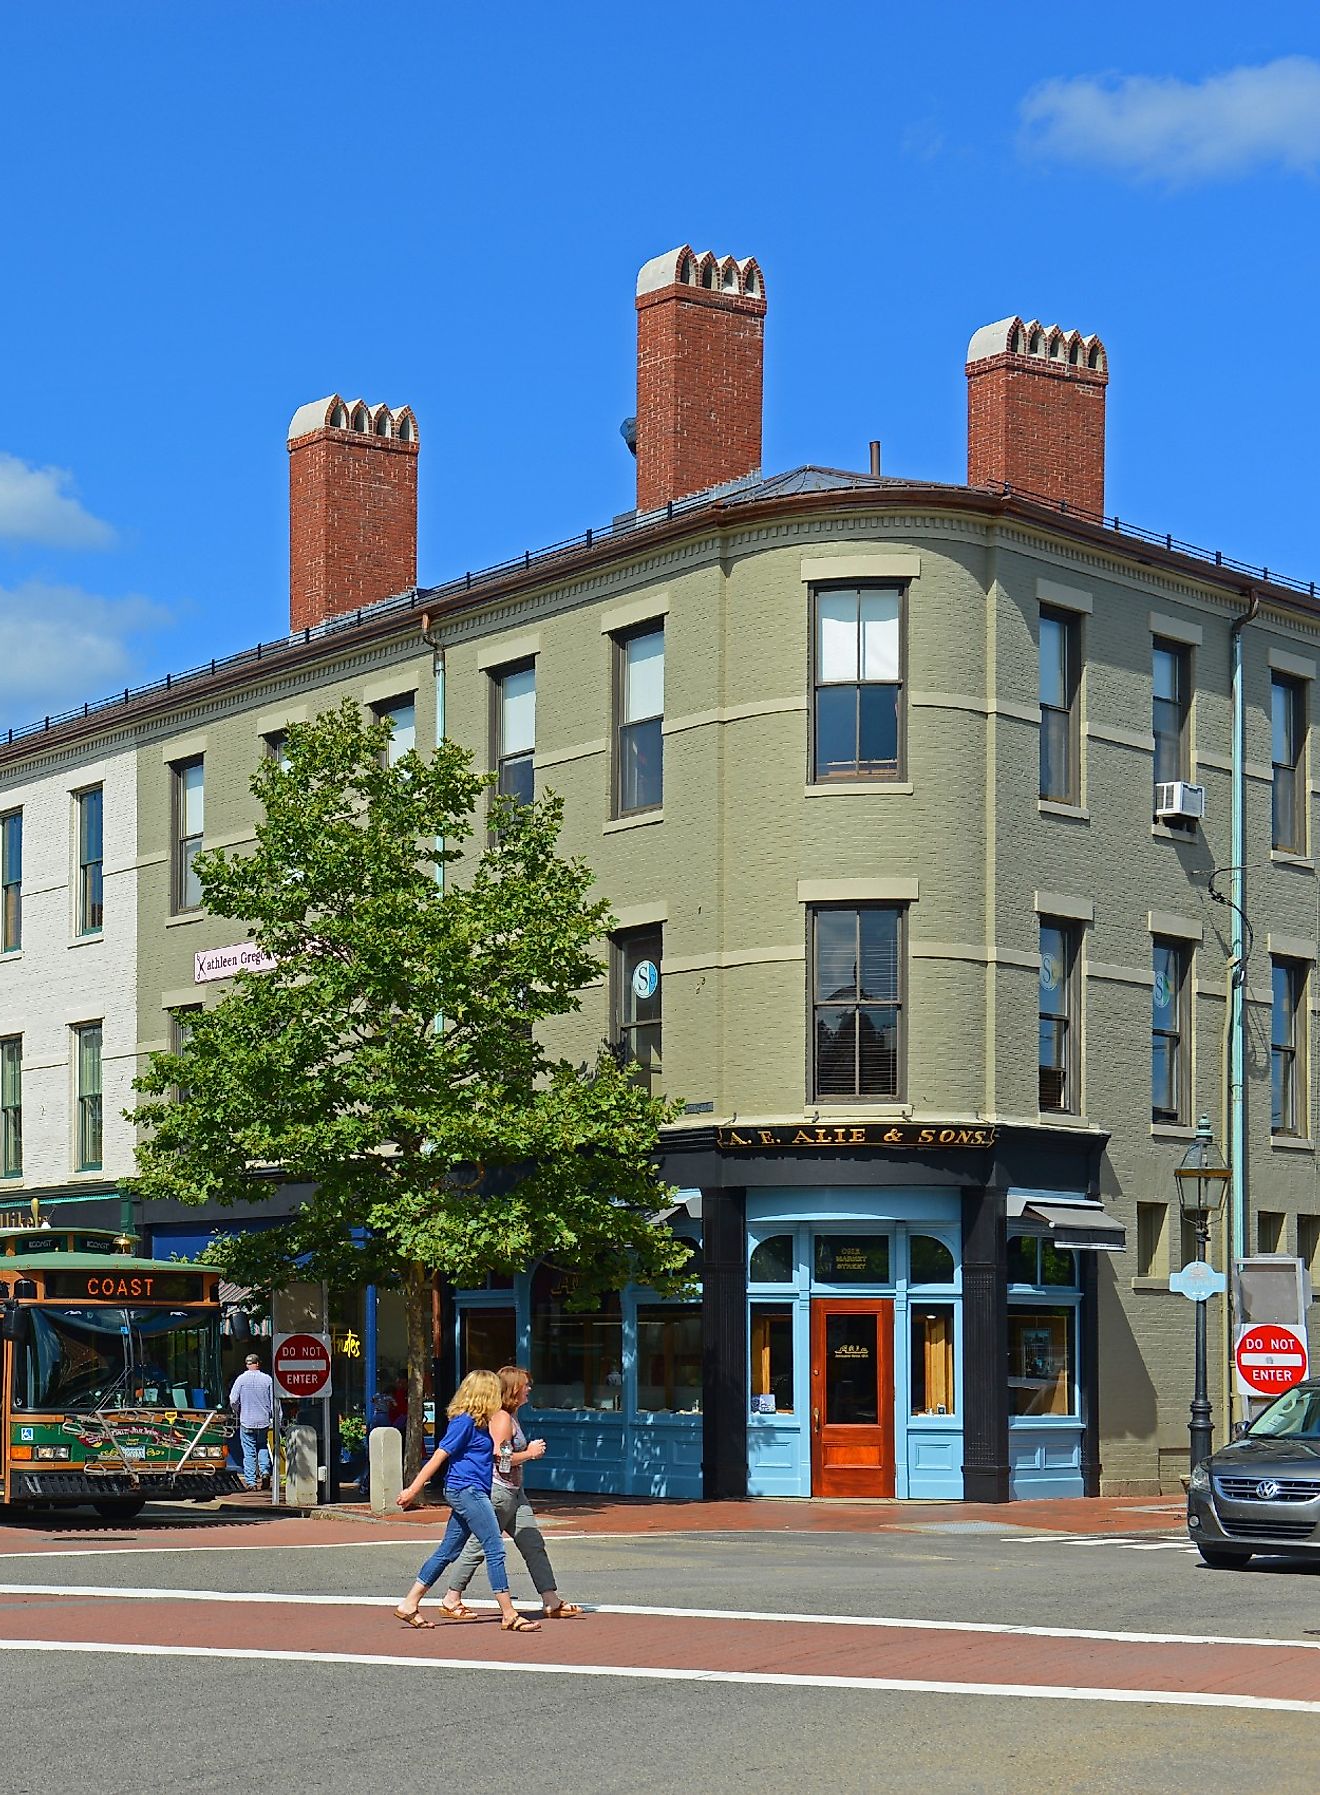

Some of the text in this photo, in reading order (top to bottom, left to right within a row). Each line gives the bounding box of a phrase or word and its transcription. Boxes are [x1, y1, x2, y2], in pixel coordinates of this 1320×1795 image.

[197, 954, 238, 980] Kathleen
[730, 1131, 753, 1146] A.
[758, 1130, 781, 1144] E.
[792, 1128, 866, 1143] ALIE
[883, 1128, 904, 1142] &
[87, 1277, 155, 1296] COAST
[1246, 1338, 1295, 1350] DO NOT
[282, 1346, 321, 1357] DO NOT
[286, 1374, 318, 1385] ENTER
[1252, 1369, 1293, 1382] ENTER
